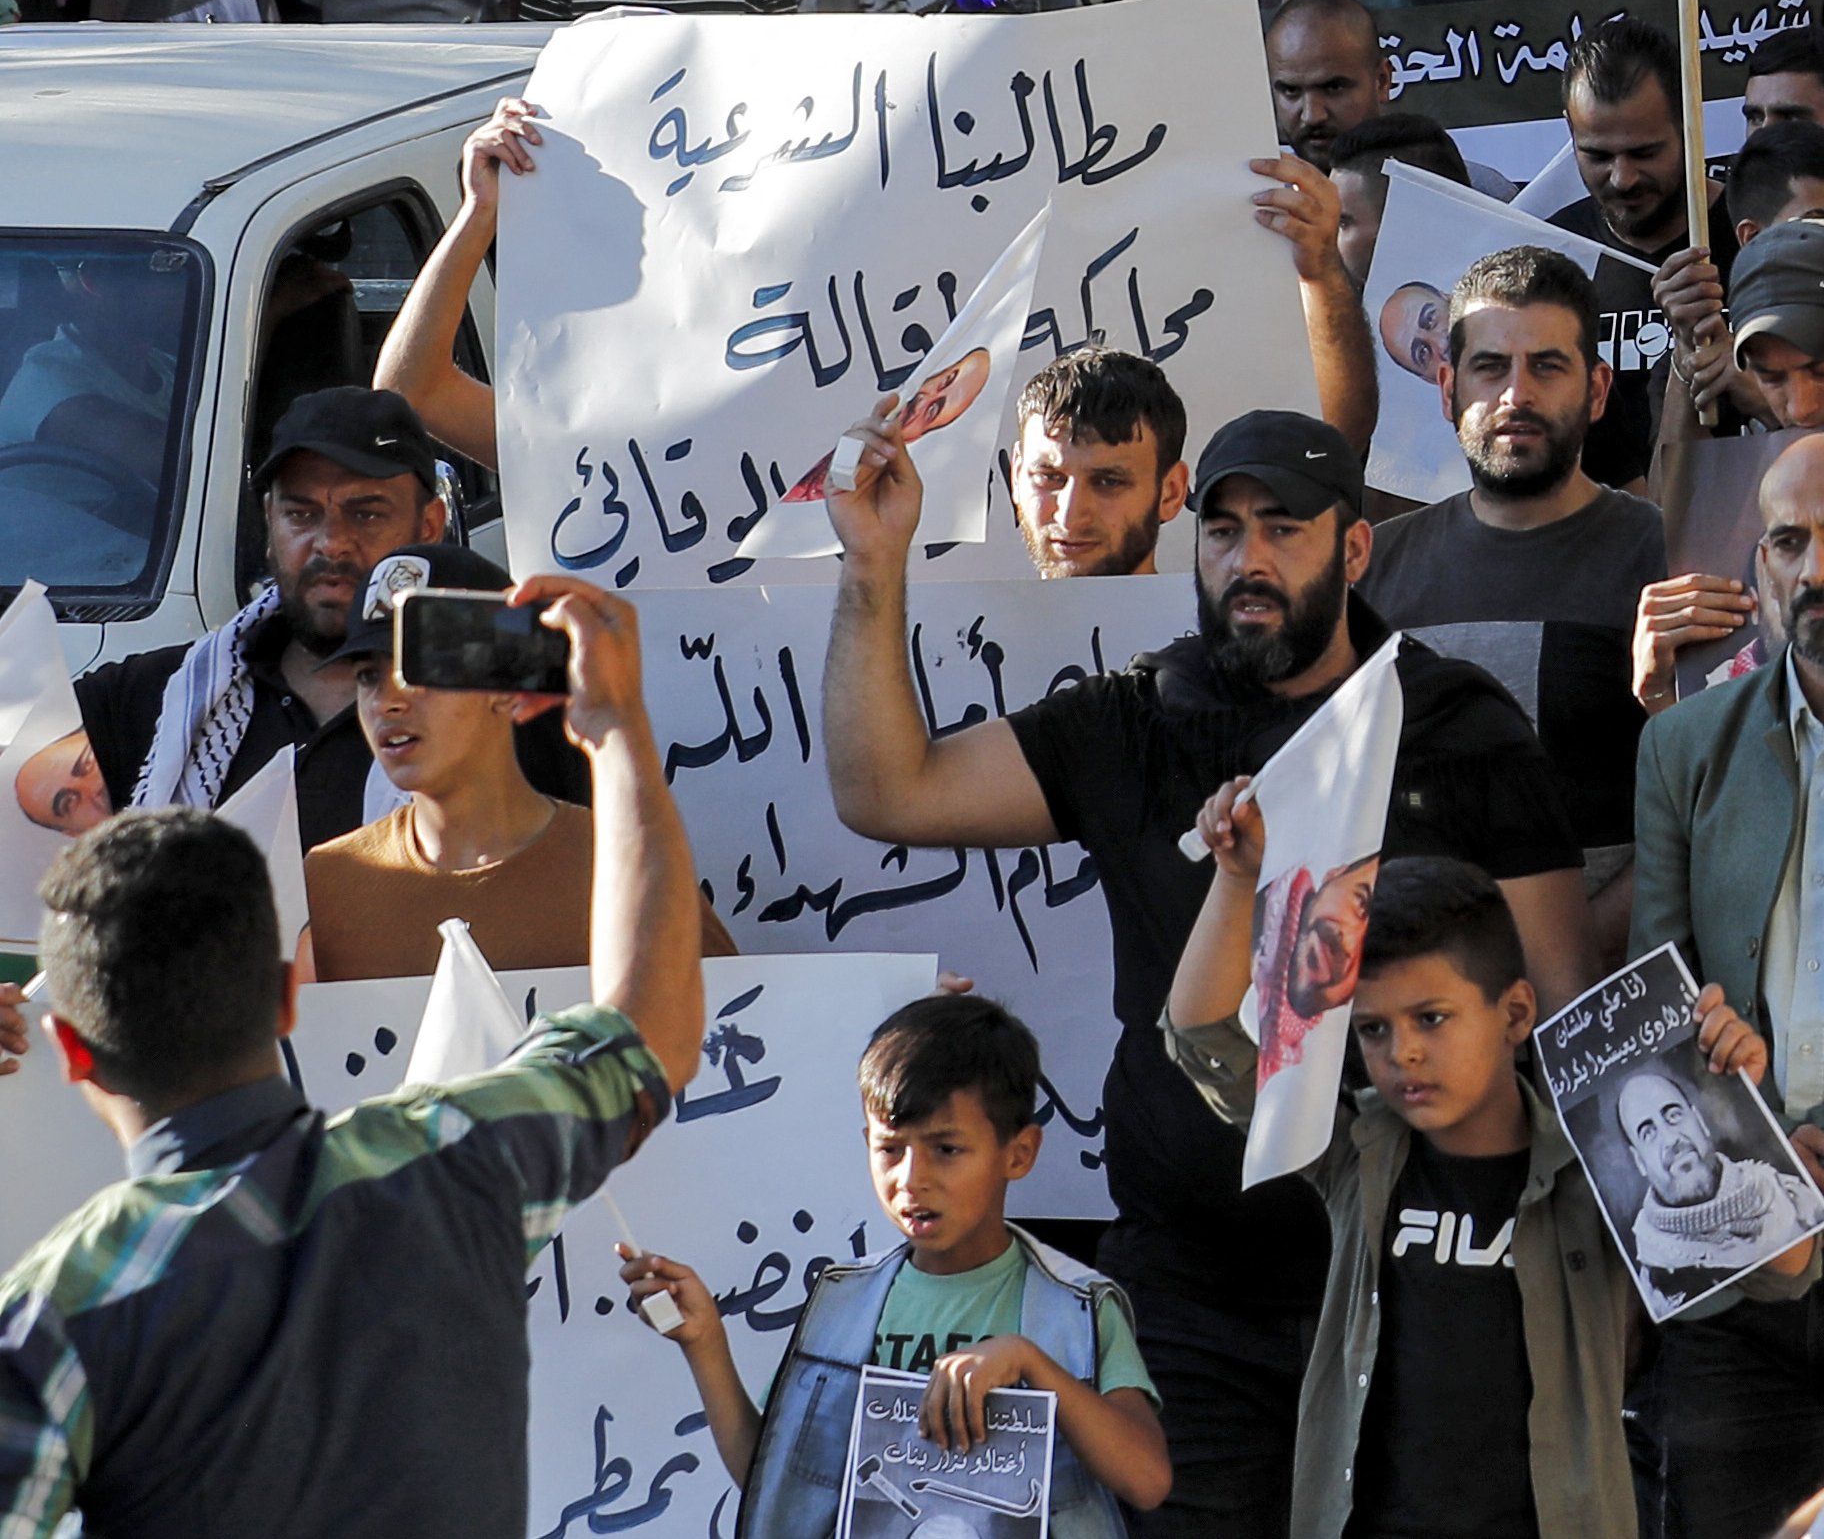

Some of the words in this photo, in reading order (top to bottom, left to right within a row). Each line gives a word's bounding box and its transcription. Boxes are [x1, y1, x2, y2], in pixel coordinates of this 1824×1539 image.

[1379, 28, 1480, 101] الحق
[648, 61, 889, 197] الشرعية
[927, 51, 1169, 213] مطالبنا
[1555, 1008, 1594, 1049] علشان
[1584, 1035, 1642, 1076] يعيشوا
[866, 1396, 921, 1425] تلات
[985, 1405, 1050, 1436] سلطتنا
[883, 1440, 929, 1473] بنات
